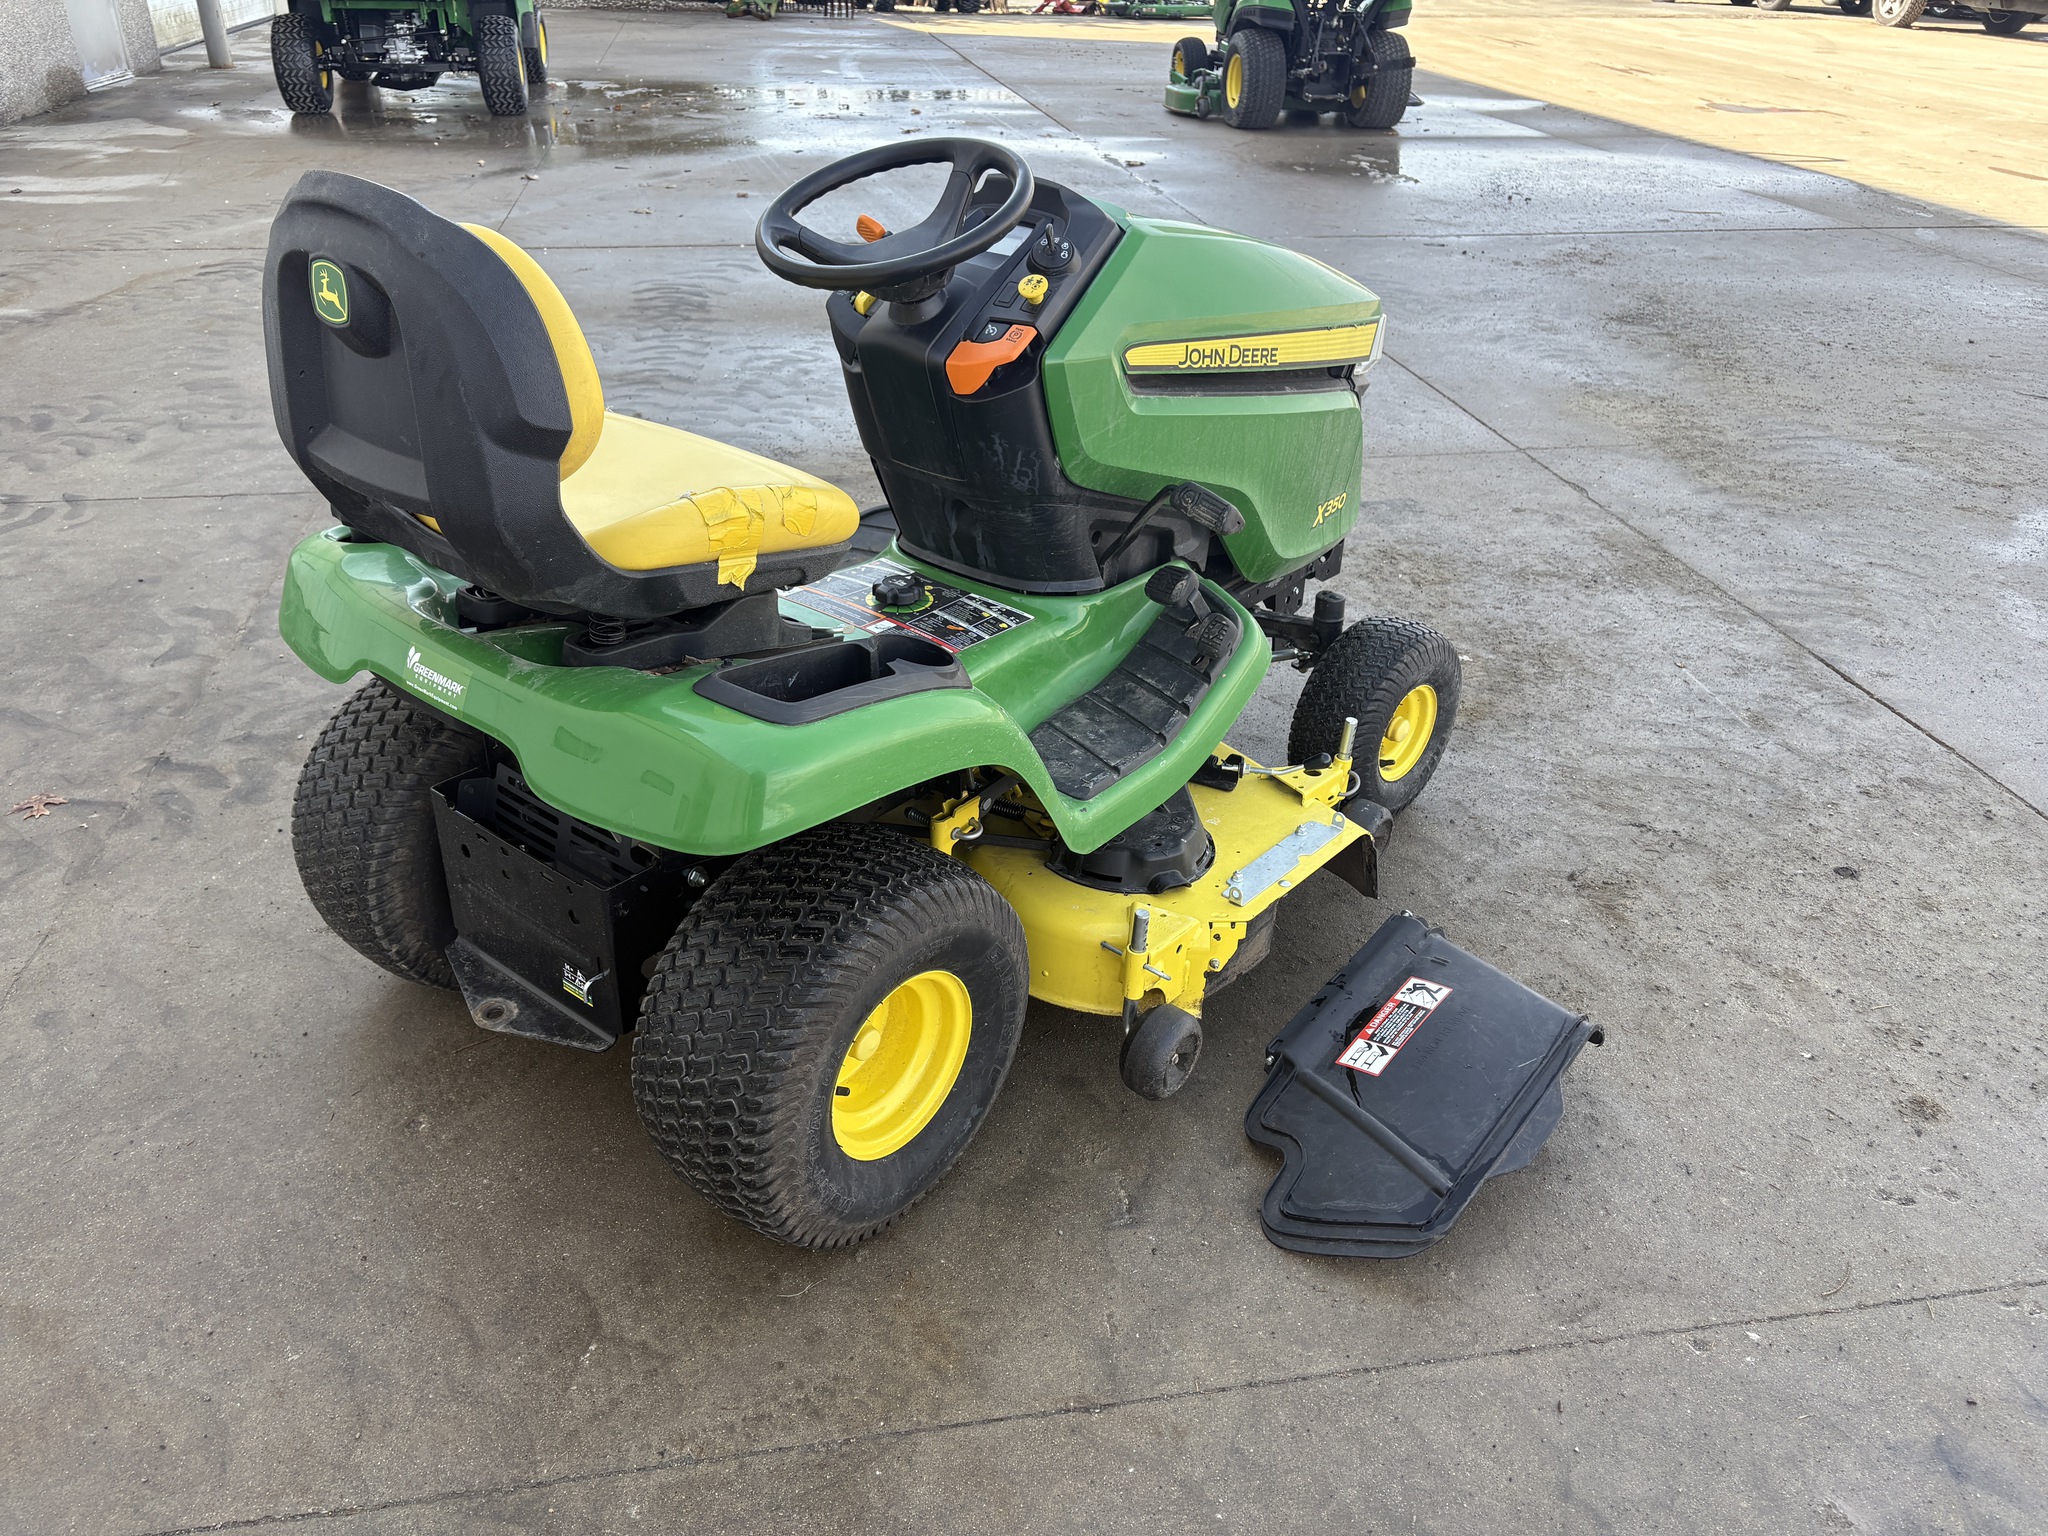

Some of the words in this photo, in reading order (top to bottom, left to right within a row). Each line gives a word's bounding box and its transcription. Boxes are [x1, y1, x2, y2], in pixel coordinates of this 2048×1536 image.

[1178, 344, 1225, 367] JOHN
[1229, 344, 1279, 366] DEERE
[1312, 492, 1347, 528] X350
[413, 662, 464, 695] GREENMARK
[1370, 1002, 1397, 1028] DANGER
